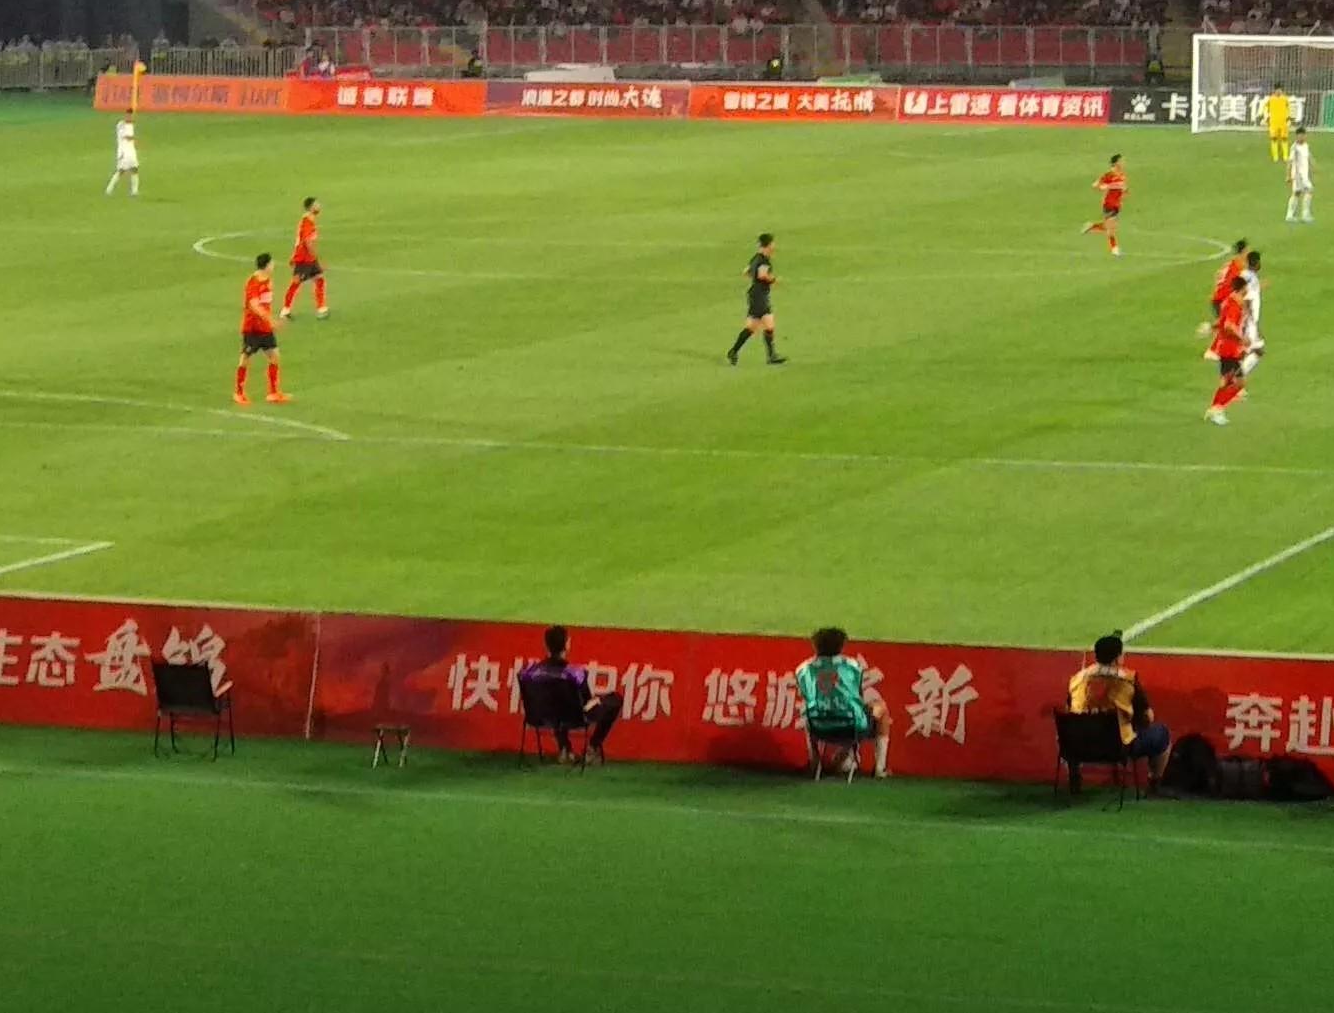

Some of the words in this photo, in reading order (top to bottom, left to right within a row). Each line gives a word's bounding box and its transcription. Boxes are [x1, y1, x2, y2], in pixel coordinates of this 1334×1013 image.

[997, 93, 1104, 117] 看体育资讯
